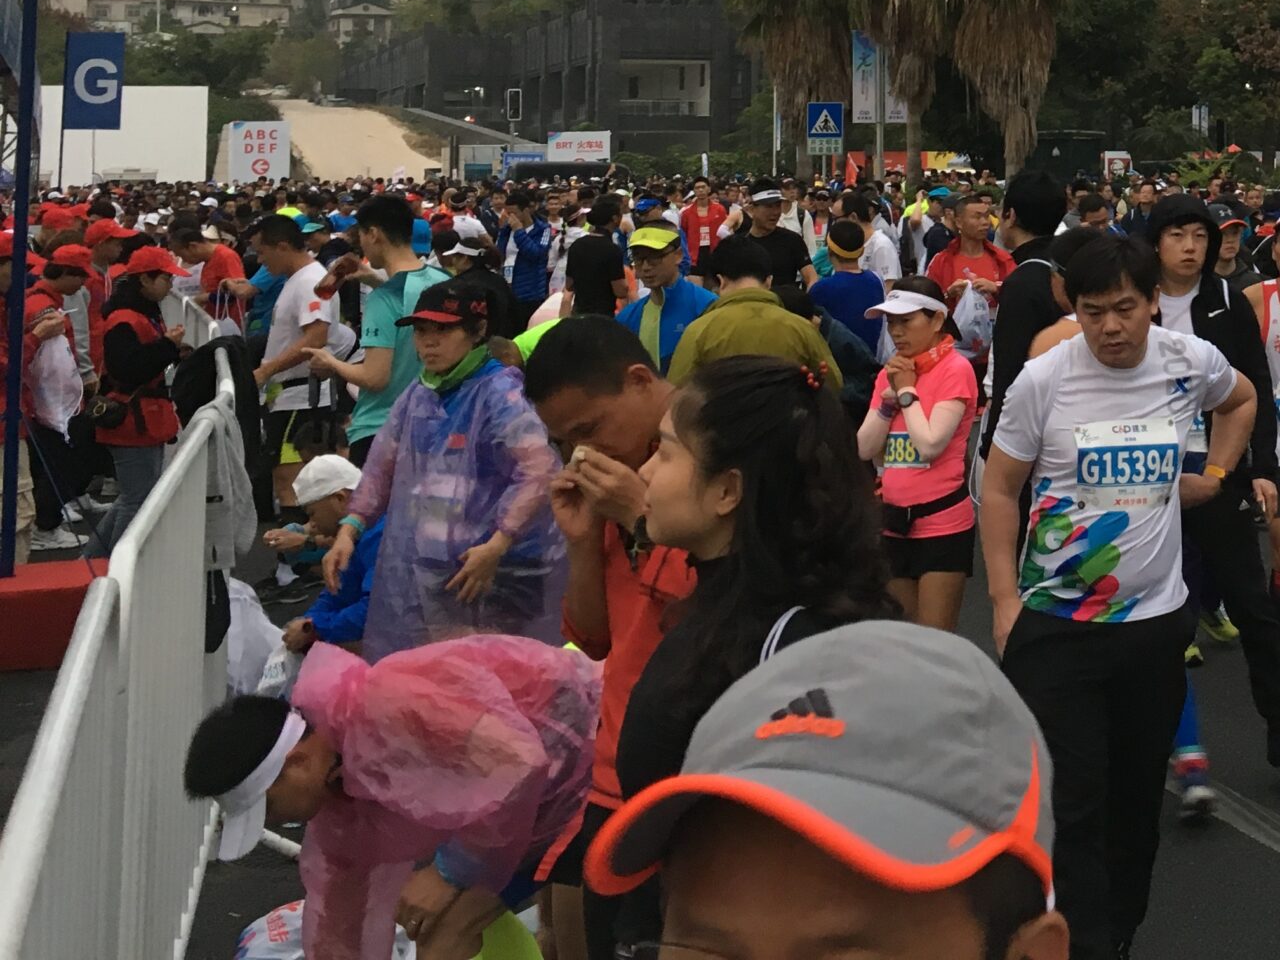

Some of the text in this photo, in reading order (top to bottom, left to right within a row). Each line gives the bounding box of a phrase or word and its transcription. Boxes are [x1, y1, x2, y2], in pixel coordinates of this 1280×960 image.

[74, 58, 118, 104] G
[555, 140, 604, 150] BRT 火车站
[1081, 448, 1175, 484] G15394
